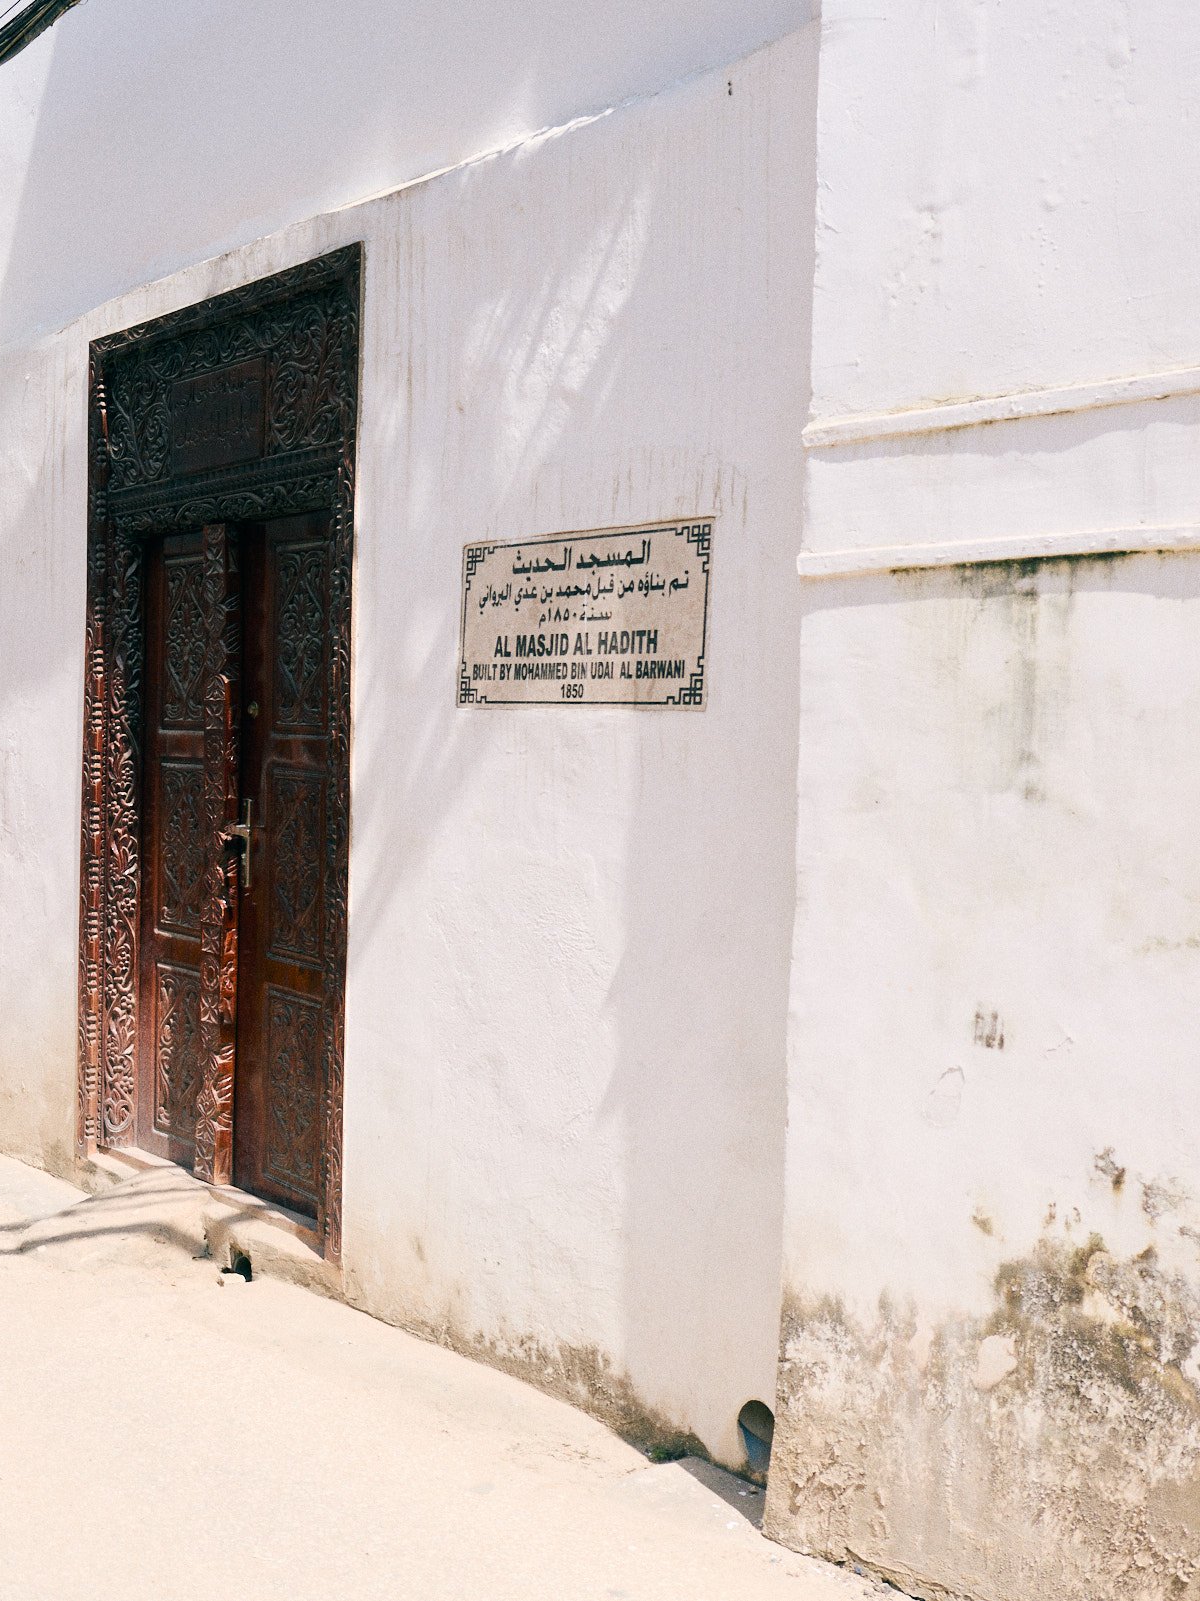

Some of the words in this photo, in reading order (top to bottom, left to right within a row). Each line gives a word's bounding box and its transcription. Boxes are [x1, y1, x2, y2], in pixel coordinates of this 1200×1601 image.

[512, 546, 572, 582] الحديث
[576, 538, 651, 576] المسجد
[540, 585, 554, 604] بن
[556, 582, 592, 599] محمد
[591, 573, 615, 601] قبل
[617, 579, 635, 599] من
[637, 571, 666, 598] بناؤه
[668, 570, 689, 598] تم
[514, 586, 538, 612] عدي
[579, 603, 613, 621] سنة
[494, 635, 512, 658] AL
[515, 633, 570, 657] MASJID
[572, 632, 593, 655] AL
[597, 629, 659, 655] HADITH
[472, 663, 498, 681] BUILT
[499, 663, 512, 681] BY
[514, 662, 568, 681] MOHAMMED
[570, 662, 588, 680] BIN
[590, 661, 614, 680] UDAI
[619, 661, 633, 679] AL
[635, 659, 686, 679] BARWANI
[560, 683, 585, 699] 1850
